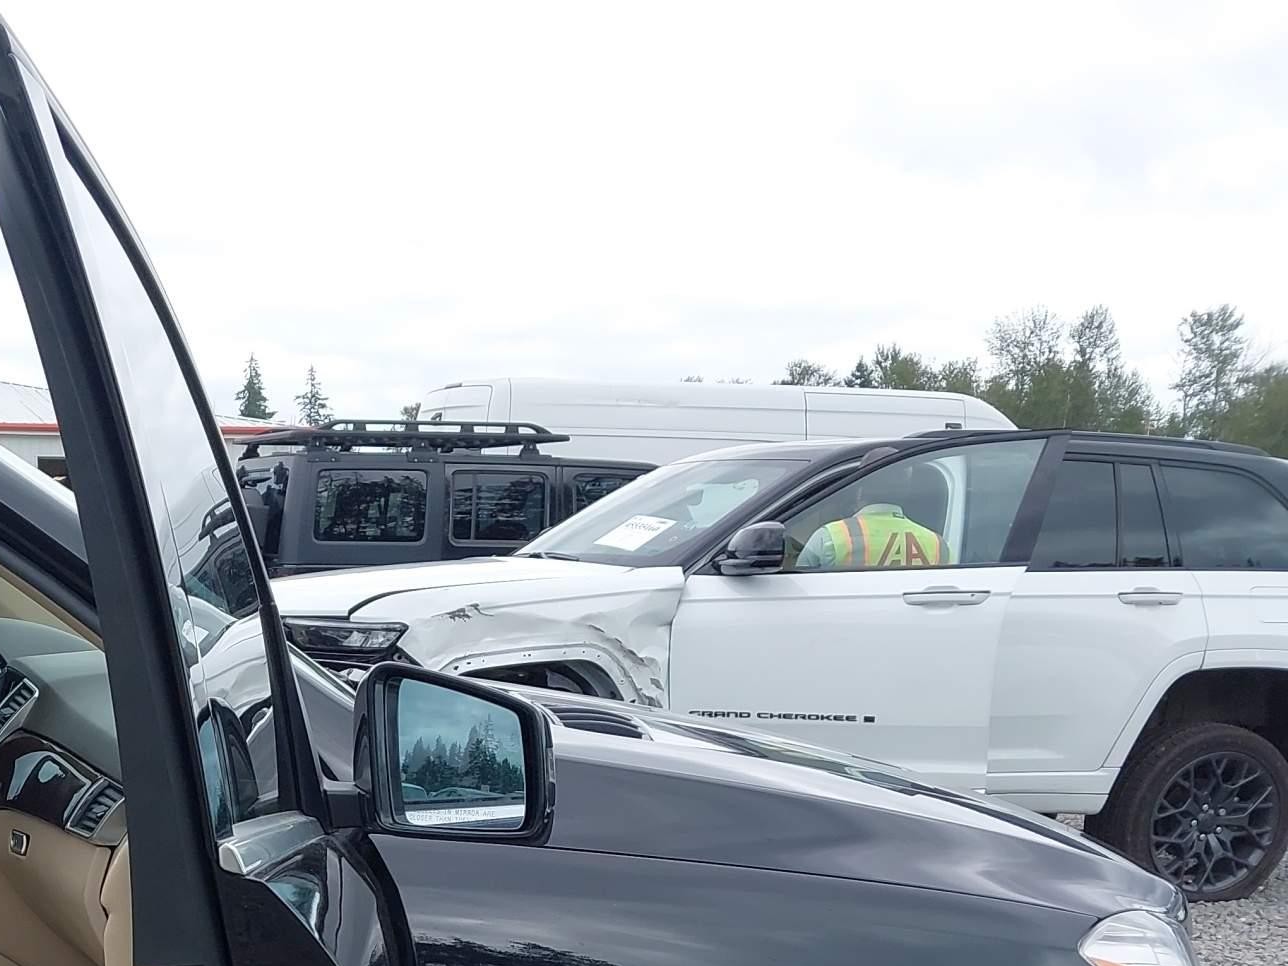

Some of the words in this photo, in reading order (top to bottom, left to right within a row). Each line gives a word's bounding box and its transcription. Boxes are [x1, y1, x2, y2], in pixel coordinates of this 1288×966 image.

[756, 712, 857, 722] CHEROKEE
[408, 813, 433, 822] CLOSER
[455, 809, 480, 817] MIRROR
[482, 809, 497, 818] ARE
